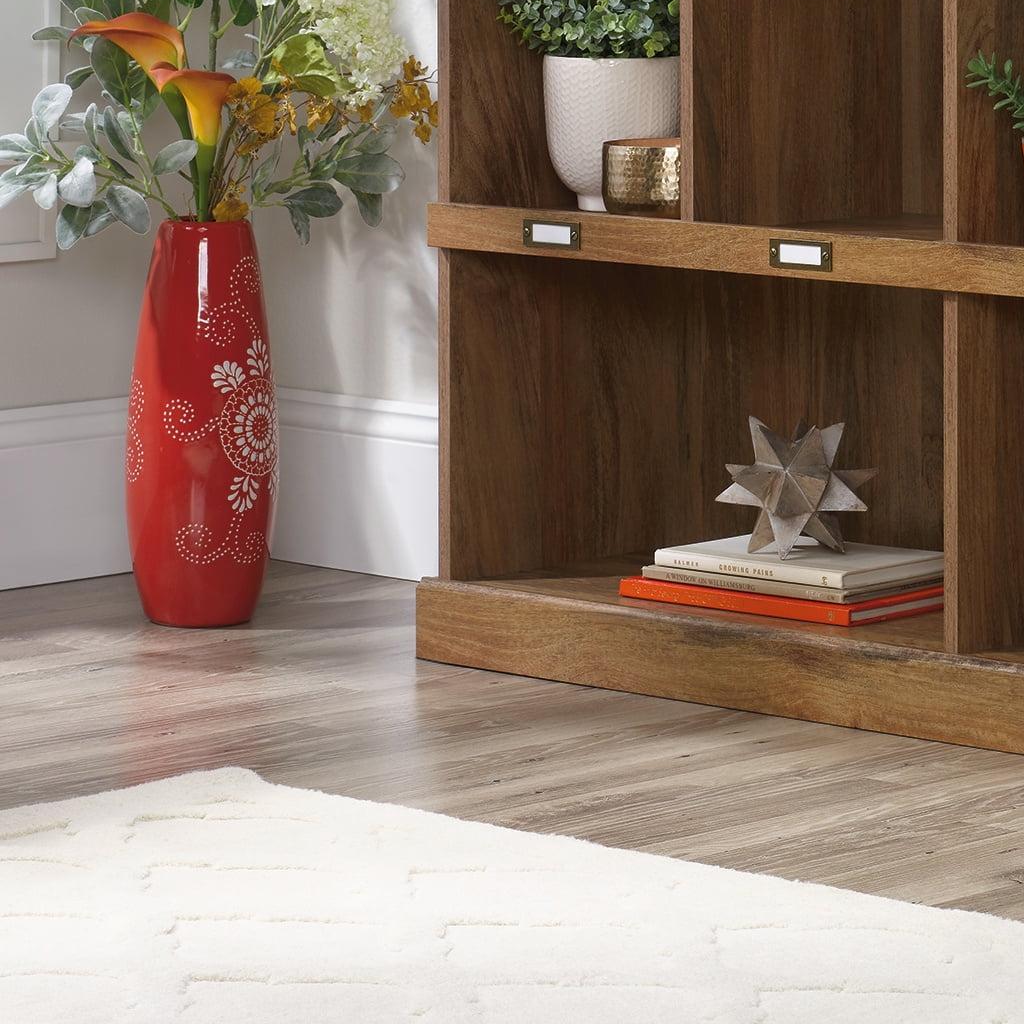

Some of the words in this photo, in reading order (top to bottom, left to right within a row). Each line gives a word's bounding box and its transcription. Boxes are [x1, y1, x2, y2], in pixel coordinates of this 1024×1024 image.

[718, 563, 750, 574] GROWING
[752, 568, 774, 577] PAINS
[671, 573, 697, 583] WINDOW
[708, 578, 756, 592] WILLIAMSBURG
